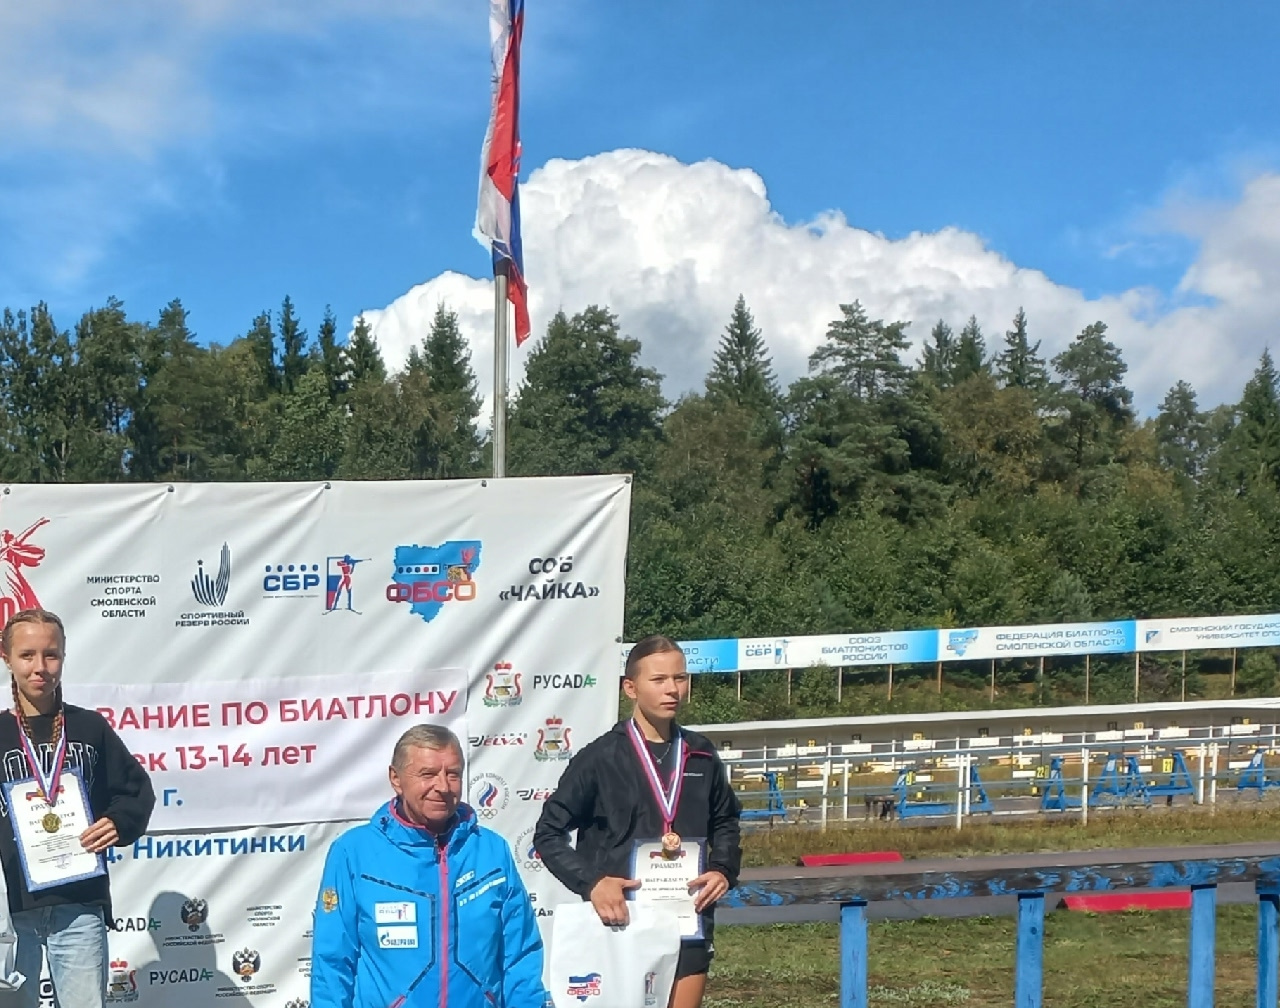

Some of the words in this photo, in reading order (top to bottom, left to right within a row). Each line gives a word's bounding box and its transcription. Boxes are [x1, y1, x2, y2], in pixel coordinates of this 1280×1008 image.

[528, 556, 573, 576] СОБ
[86, 574, 160, 585] МИНИСТЕРСТВО
[263, 573, 320, 592] СБР
[104, 586, 143, 595] СПОРТА
[386, 581, 476, 603] ФБСО
[499, 579, 600, 602] «ЧАЙКА»
[90, 596, 157, 607] СМОЛЕНСКОЙ
[101, 609, 146, 618] ОБЛАСТИ
[180, 610, 245, 621] СПОРТИВНЫЙ
[175, 618, 210, 627] РЕЗЕРВ
[211, 617, 250, 626] РОССИИ
[1234, 622, 1280, 631] ГОСУДАРС
[995, 631, 1063, 641] ФЕДЕРАЦИЯ
[1065, 627, 1123, 637] БИАТЛОНА
[849, 636, 881, 645] СОЮЗ
[996, 641, 1071, 651] СМОЛЕНСКОЙ
[1073, 638, 1125, 648] ОБЛАСТИ
[745, 648, 772, 657] СБР
[821, 643, 909, 655] БИАТЛОНИСТОВ
[842, 653, 888, 662] РОССИИ
[222, 701, 269, 727] ПО
[279, 690, 458, 722] БИАТЛОНУ
[175, 743, 253, 770] 13-14
[261, 744, 317, 766] лет
[133, 834, 306, 859] Никитинки
